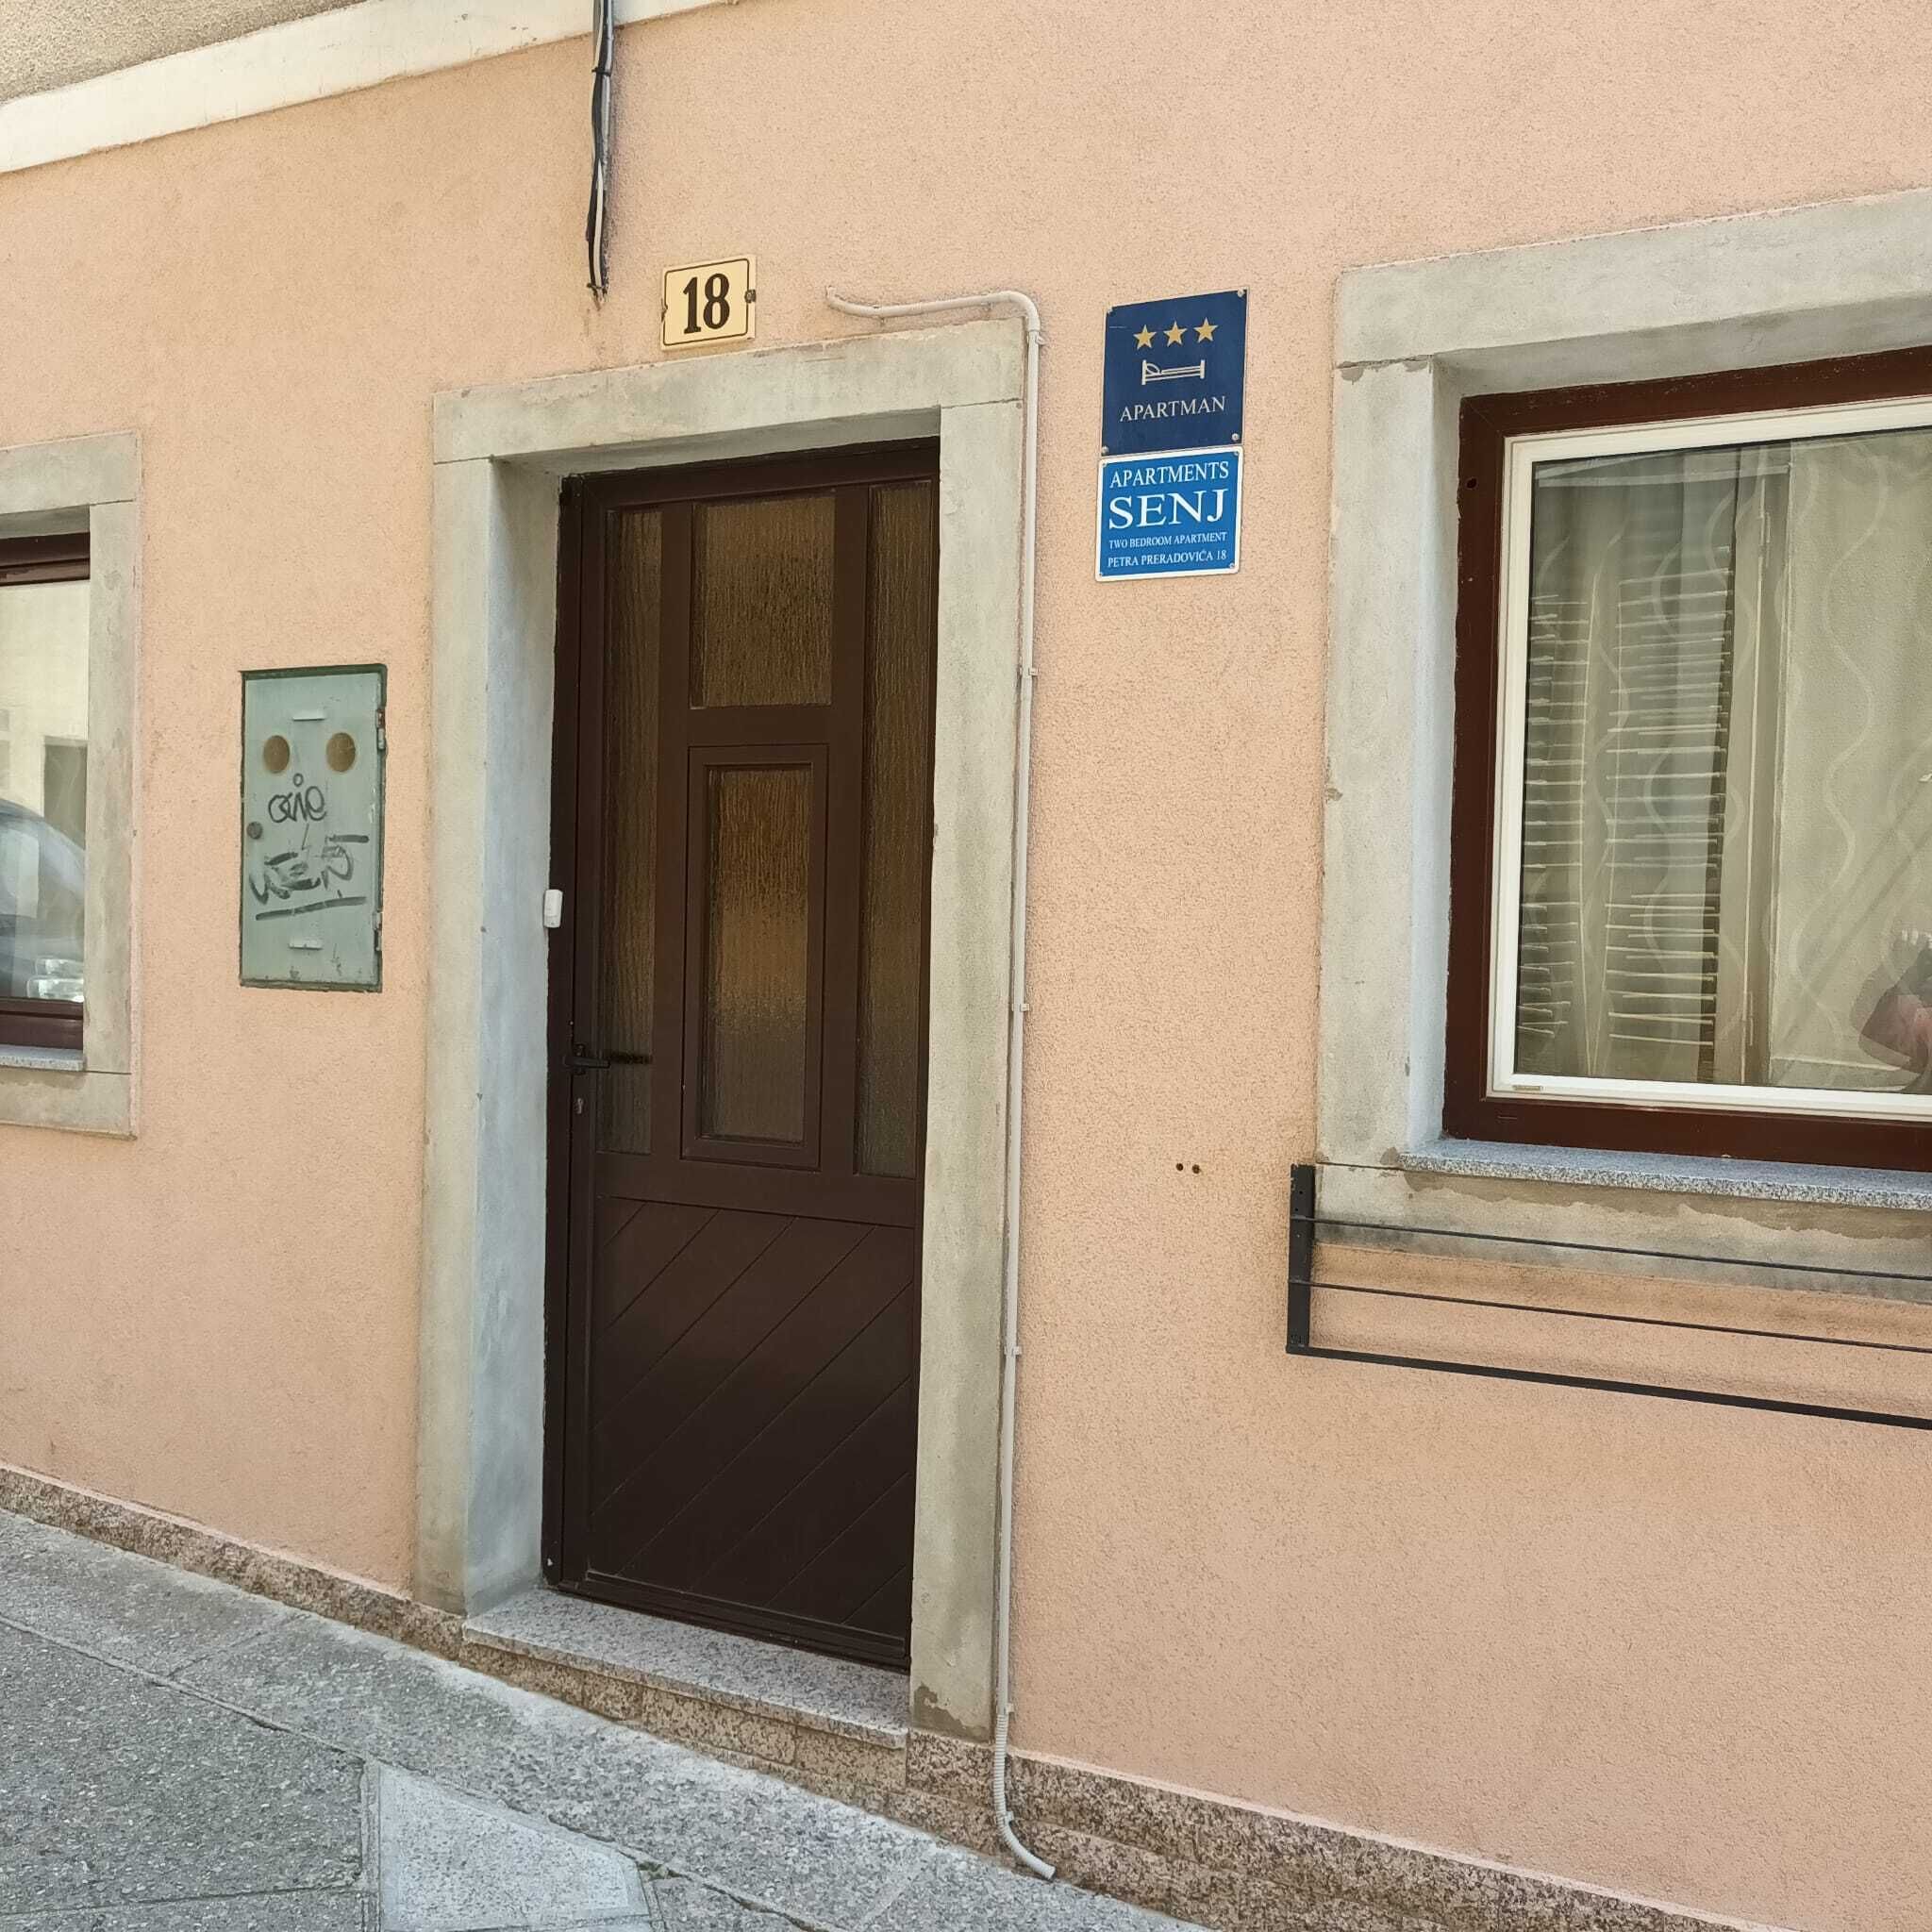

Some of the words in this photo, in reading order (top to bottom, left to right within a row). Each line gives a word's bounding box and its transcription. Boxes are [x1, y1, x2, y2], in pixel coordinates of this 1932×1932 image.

[683, 273, 730, 335] 18
[1120, 395, 1225, 422] APARTMAN
[1109, 460, 1229, 489] APARTMENTS
[1108, 489, 1229, 530] SENJ
[1108, 538, 1128, 549] TWO
[1129, 535, 1173, 548] BEDROOM
[1174, 531, 1227, 544] APARTMENT
[1108, 555, 1139, 568] PETRA
[1216, 550, 1227, 560] 18
